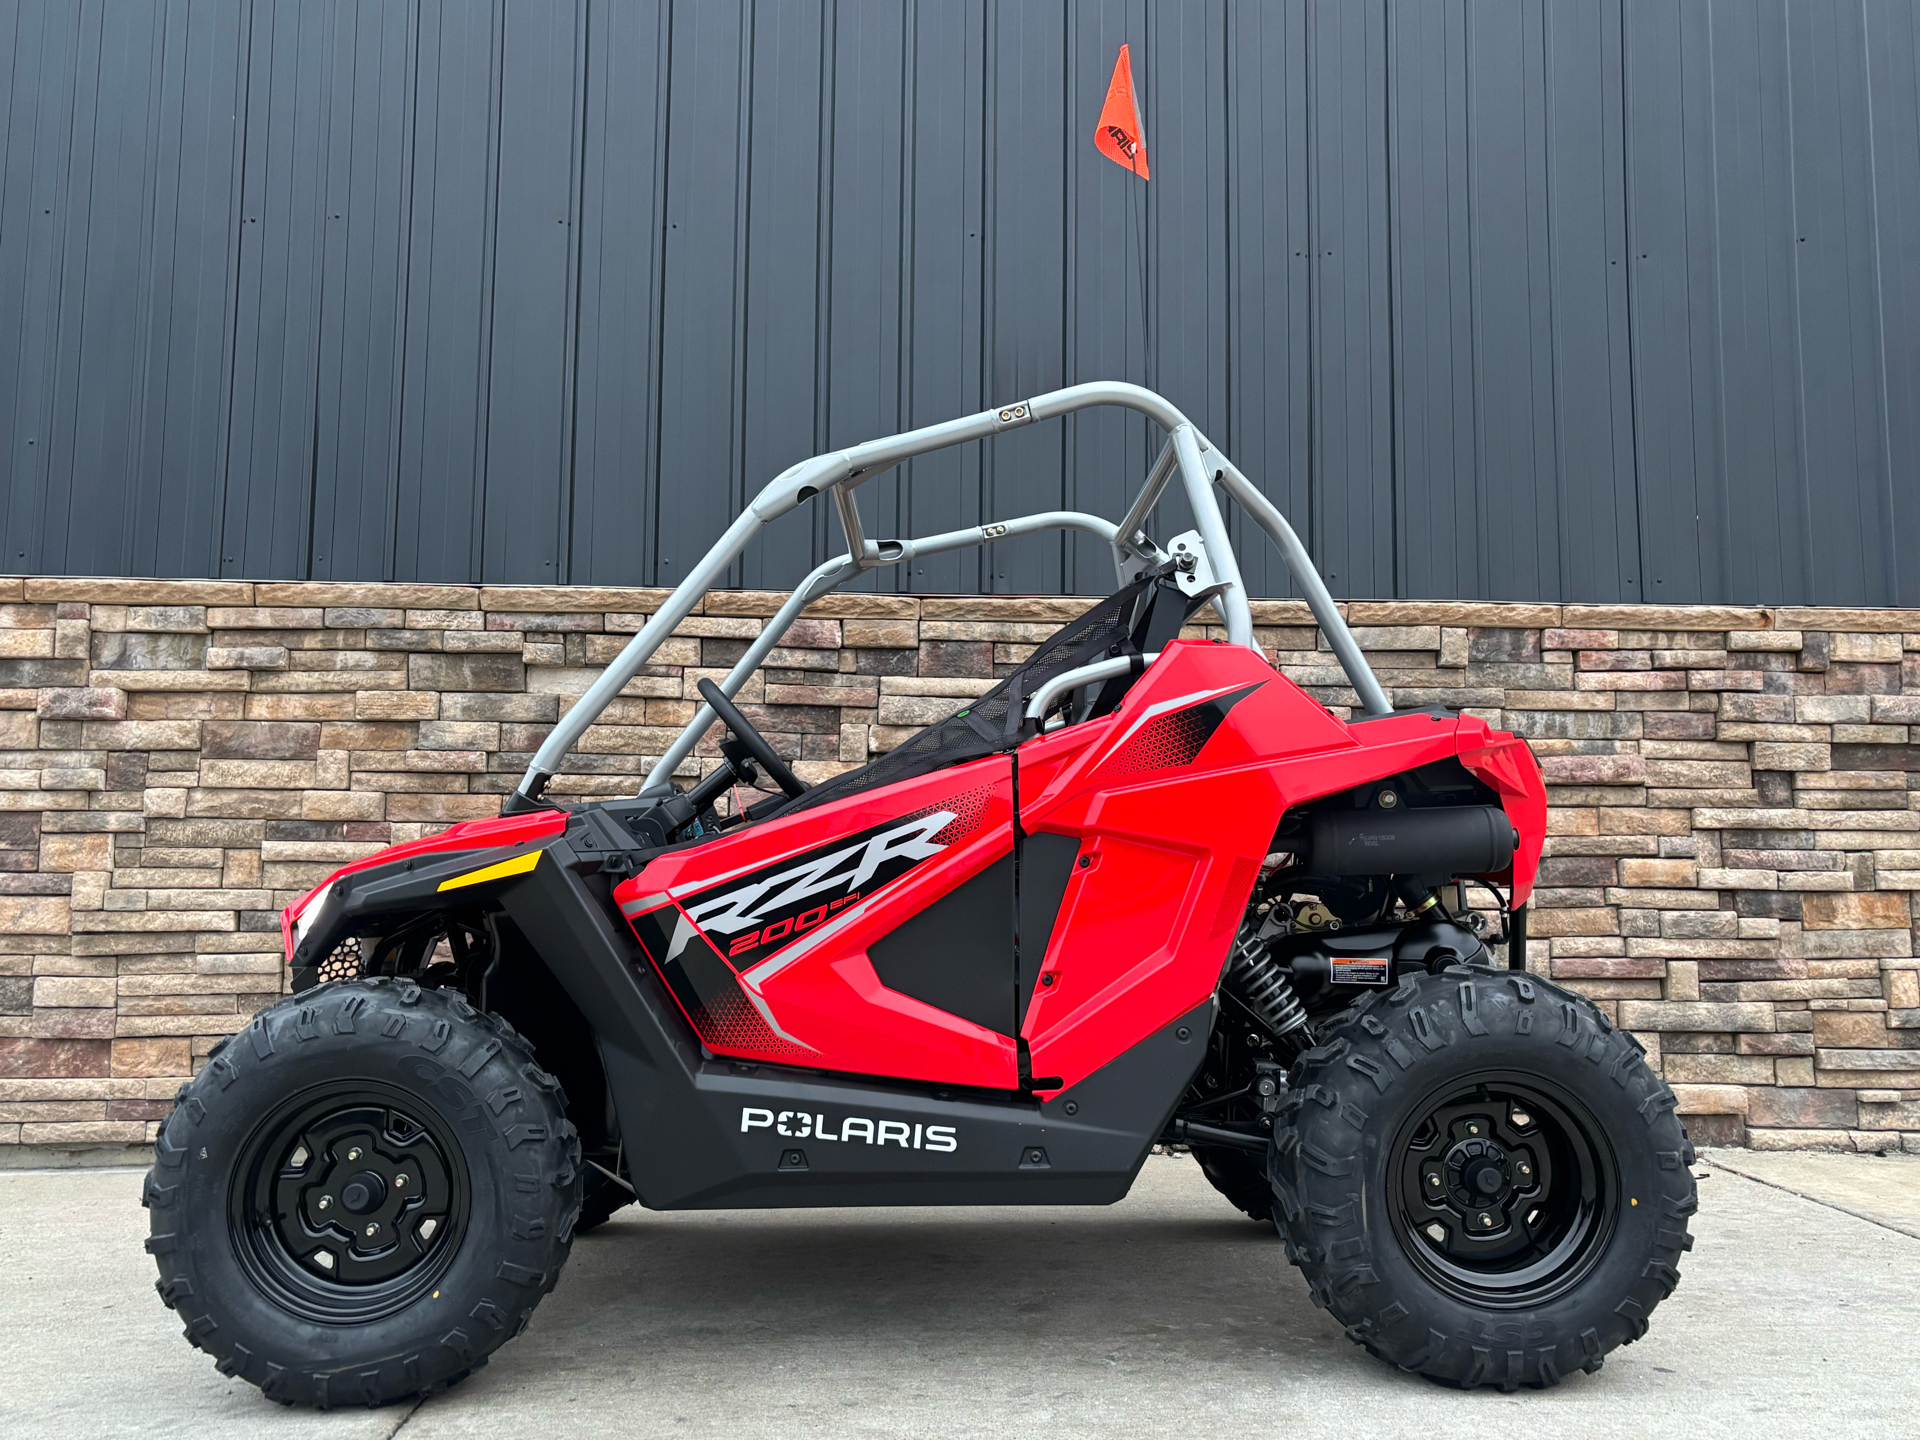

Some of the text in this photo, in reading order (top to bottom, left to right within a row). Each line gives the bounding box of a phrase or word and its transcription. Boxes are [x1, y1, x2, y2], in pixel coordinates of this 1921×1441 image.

[664, 810, 959, 965] RZR
[728, 891, 861, 957] 200 EFI
[397, 1053, 500, 1141] CST
[740, 1107, 958, 1153] POLARIS
[1455, 1317, 1558, 1348] CST
